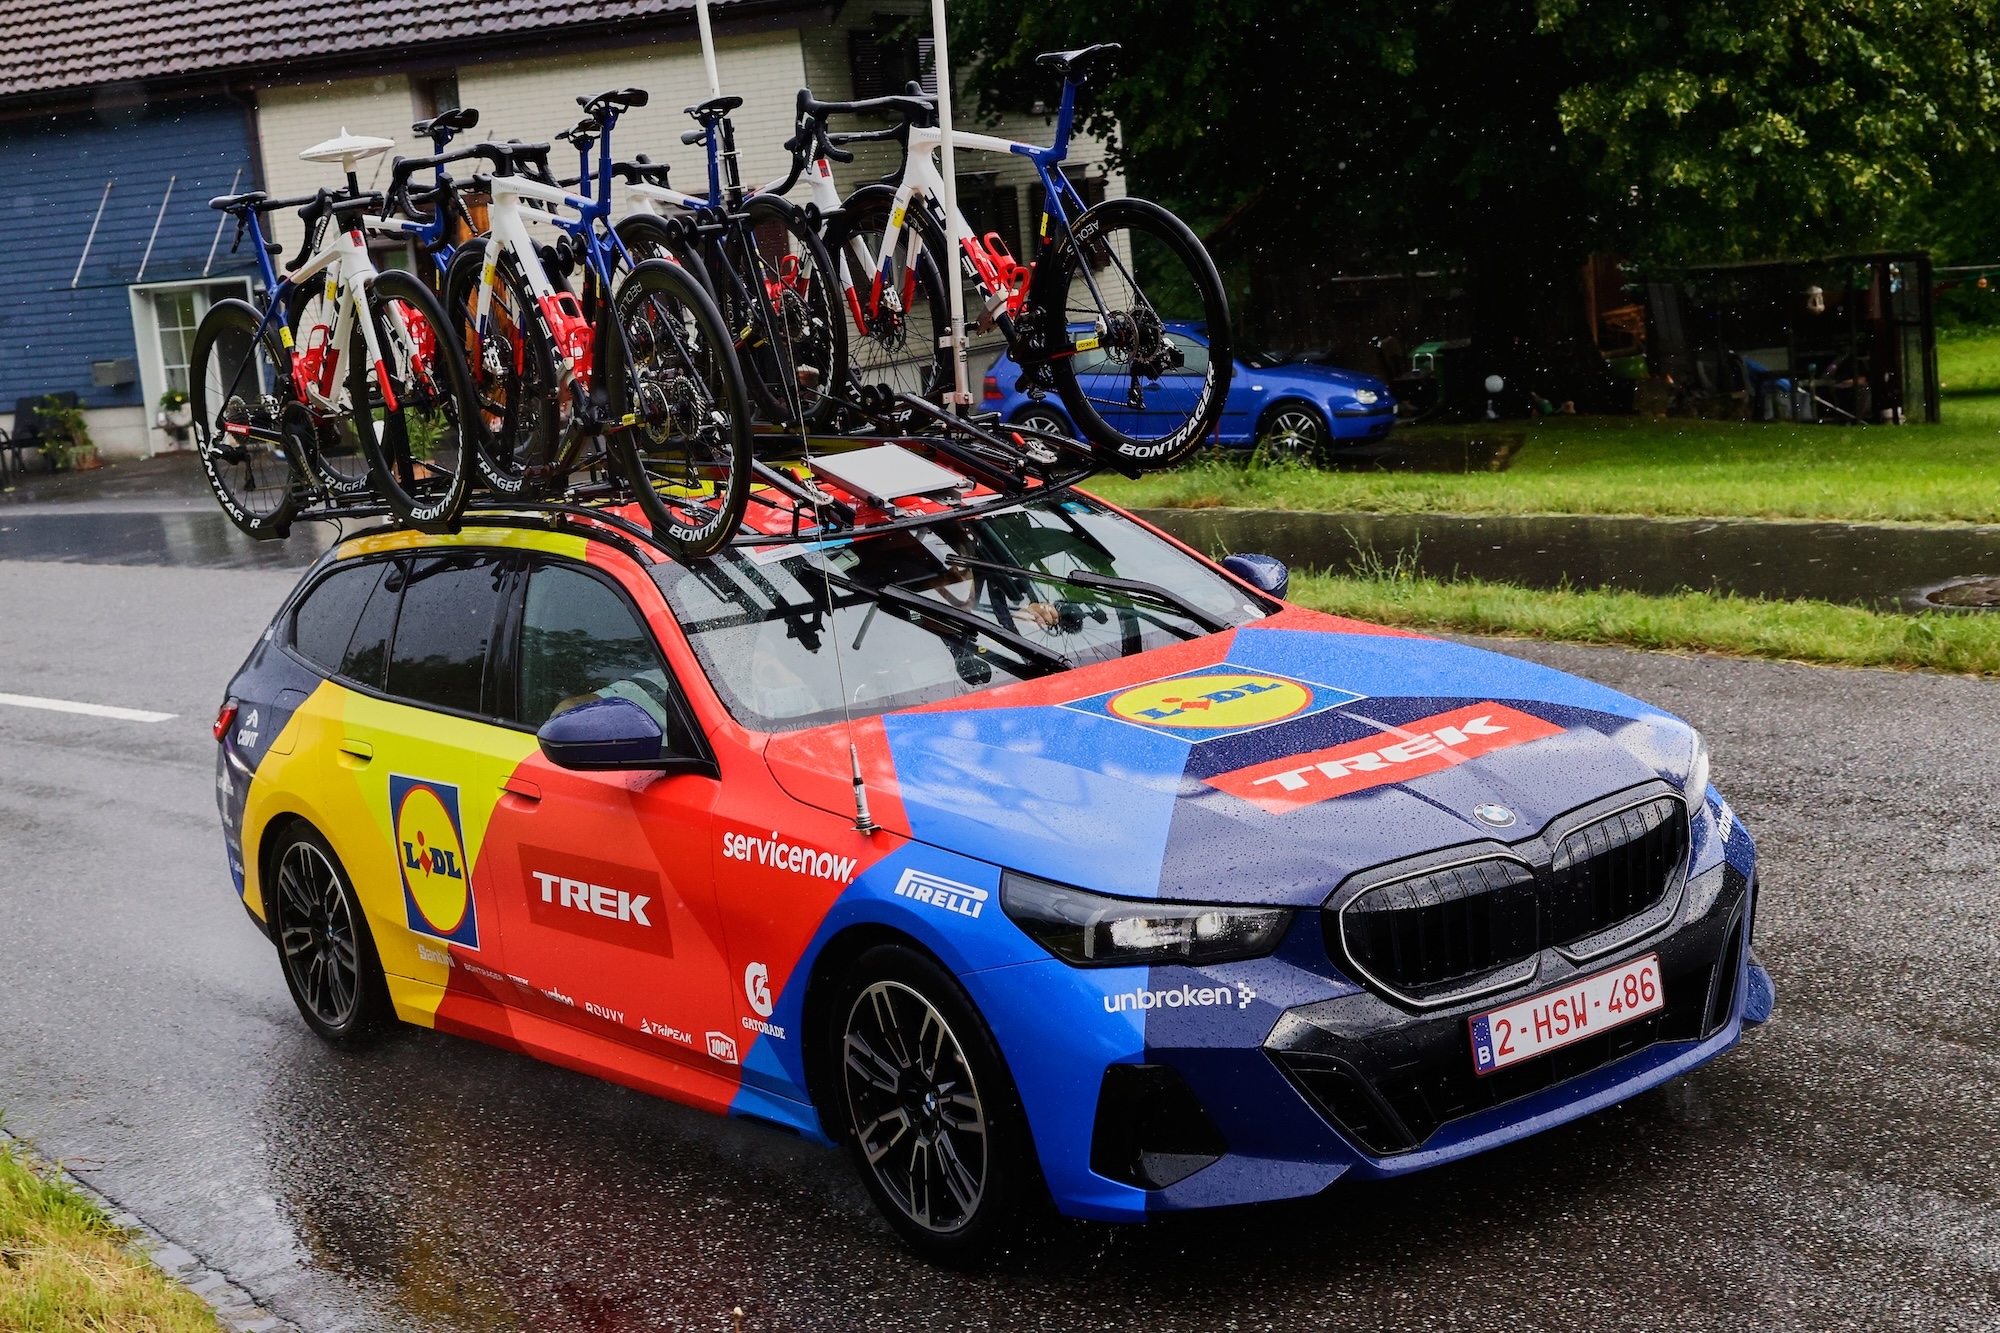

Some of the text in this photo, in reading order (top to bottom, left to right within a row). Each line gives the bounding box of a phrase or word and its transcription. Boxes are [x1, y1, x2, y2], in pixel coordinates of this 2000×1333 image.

[725, 293, 738, 337] AEOLU
[1118, 360, 1215, 458] BONTRAGER
[1252, 713, 1510, 792] TREK
[532, 870, 652, 927] TREK
[894, 867, 990, 919] PIRELLI
[584, 1001, 625, 1024] ROUVY
[1103, 986, 1233, 1013] unbroken
[1496, 966, 1657, 1058] 2-HSW-486
[710, 1038, 734, 1060] 100%
[741, 1016, 786, 1040] GATORADE
[1477, 1046, 1492, 1065] B
